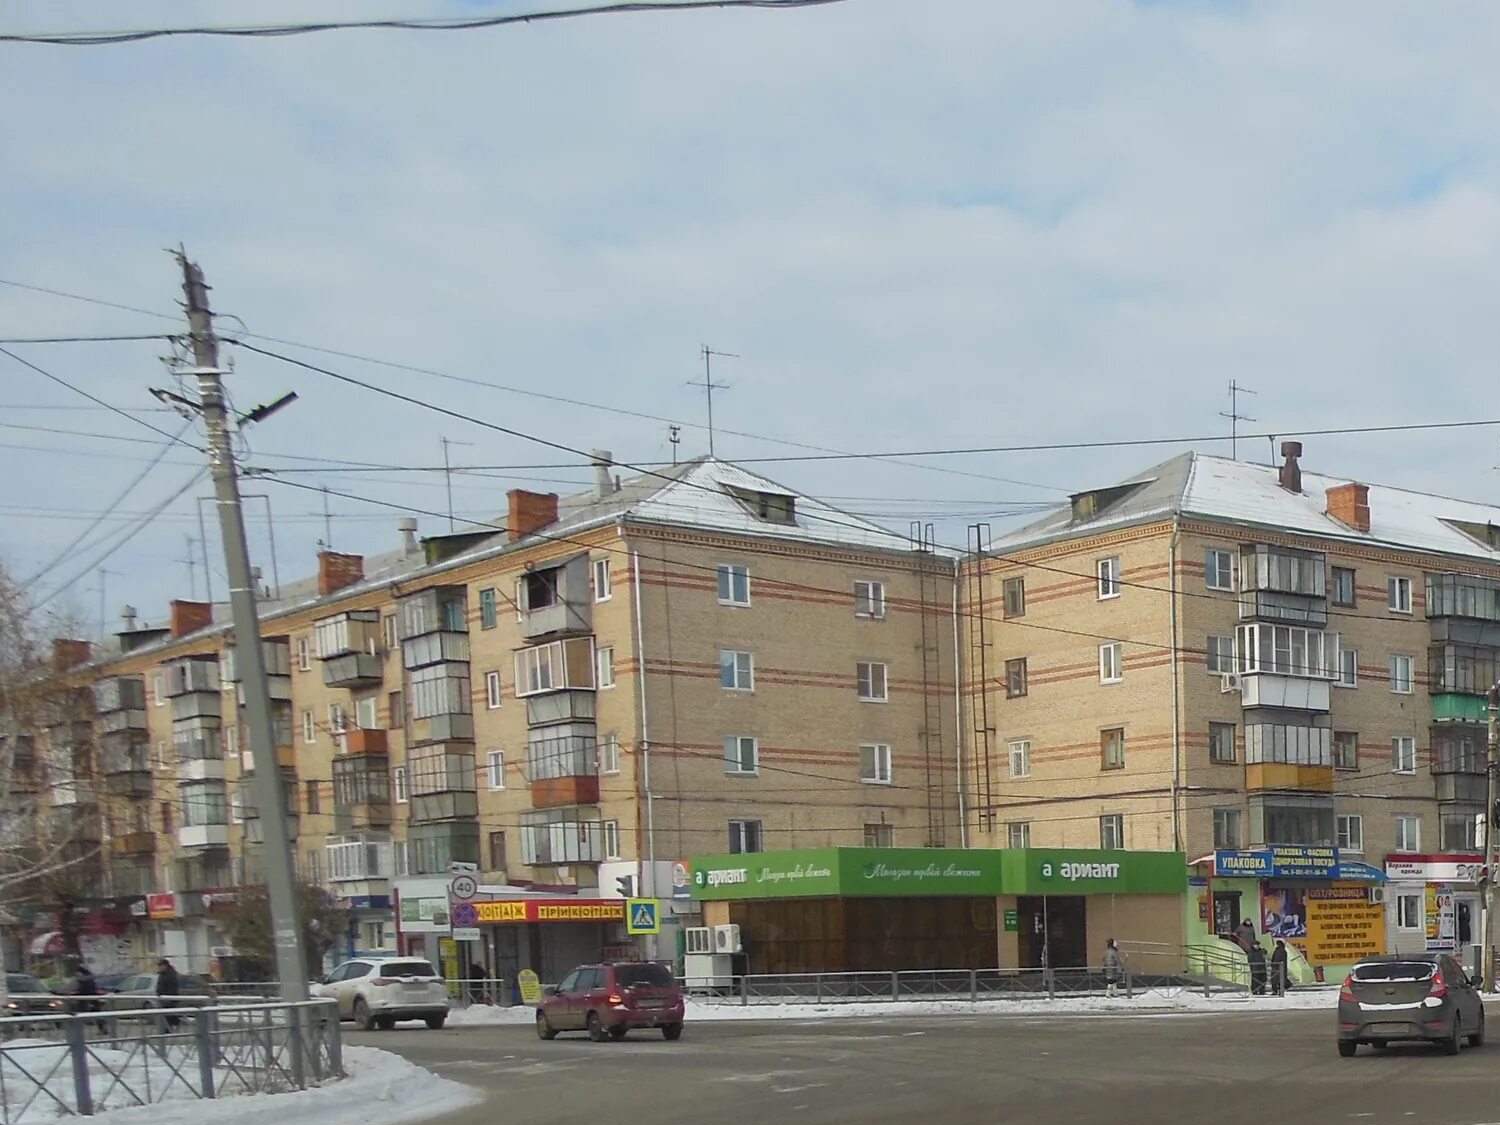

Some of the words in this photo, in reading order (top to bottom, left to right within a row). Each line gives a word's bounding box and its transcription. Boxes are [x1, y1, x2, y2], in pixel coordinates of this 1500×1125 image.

[1222, 857, 1266, 869] УПАКОВКА
[707, 868, 747, 888] ариант
[1060, 862, 1120, 882] ариант
[456, 881, 472, 893] 40
[539, 906, 623, 919] ТРИКОТАЖ
